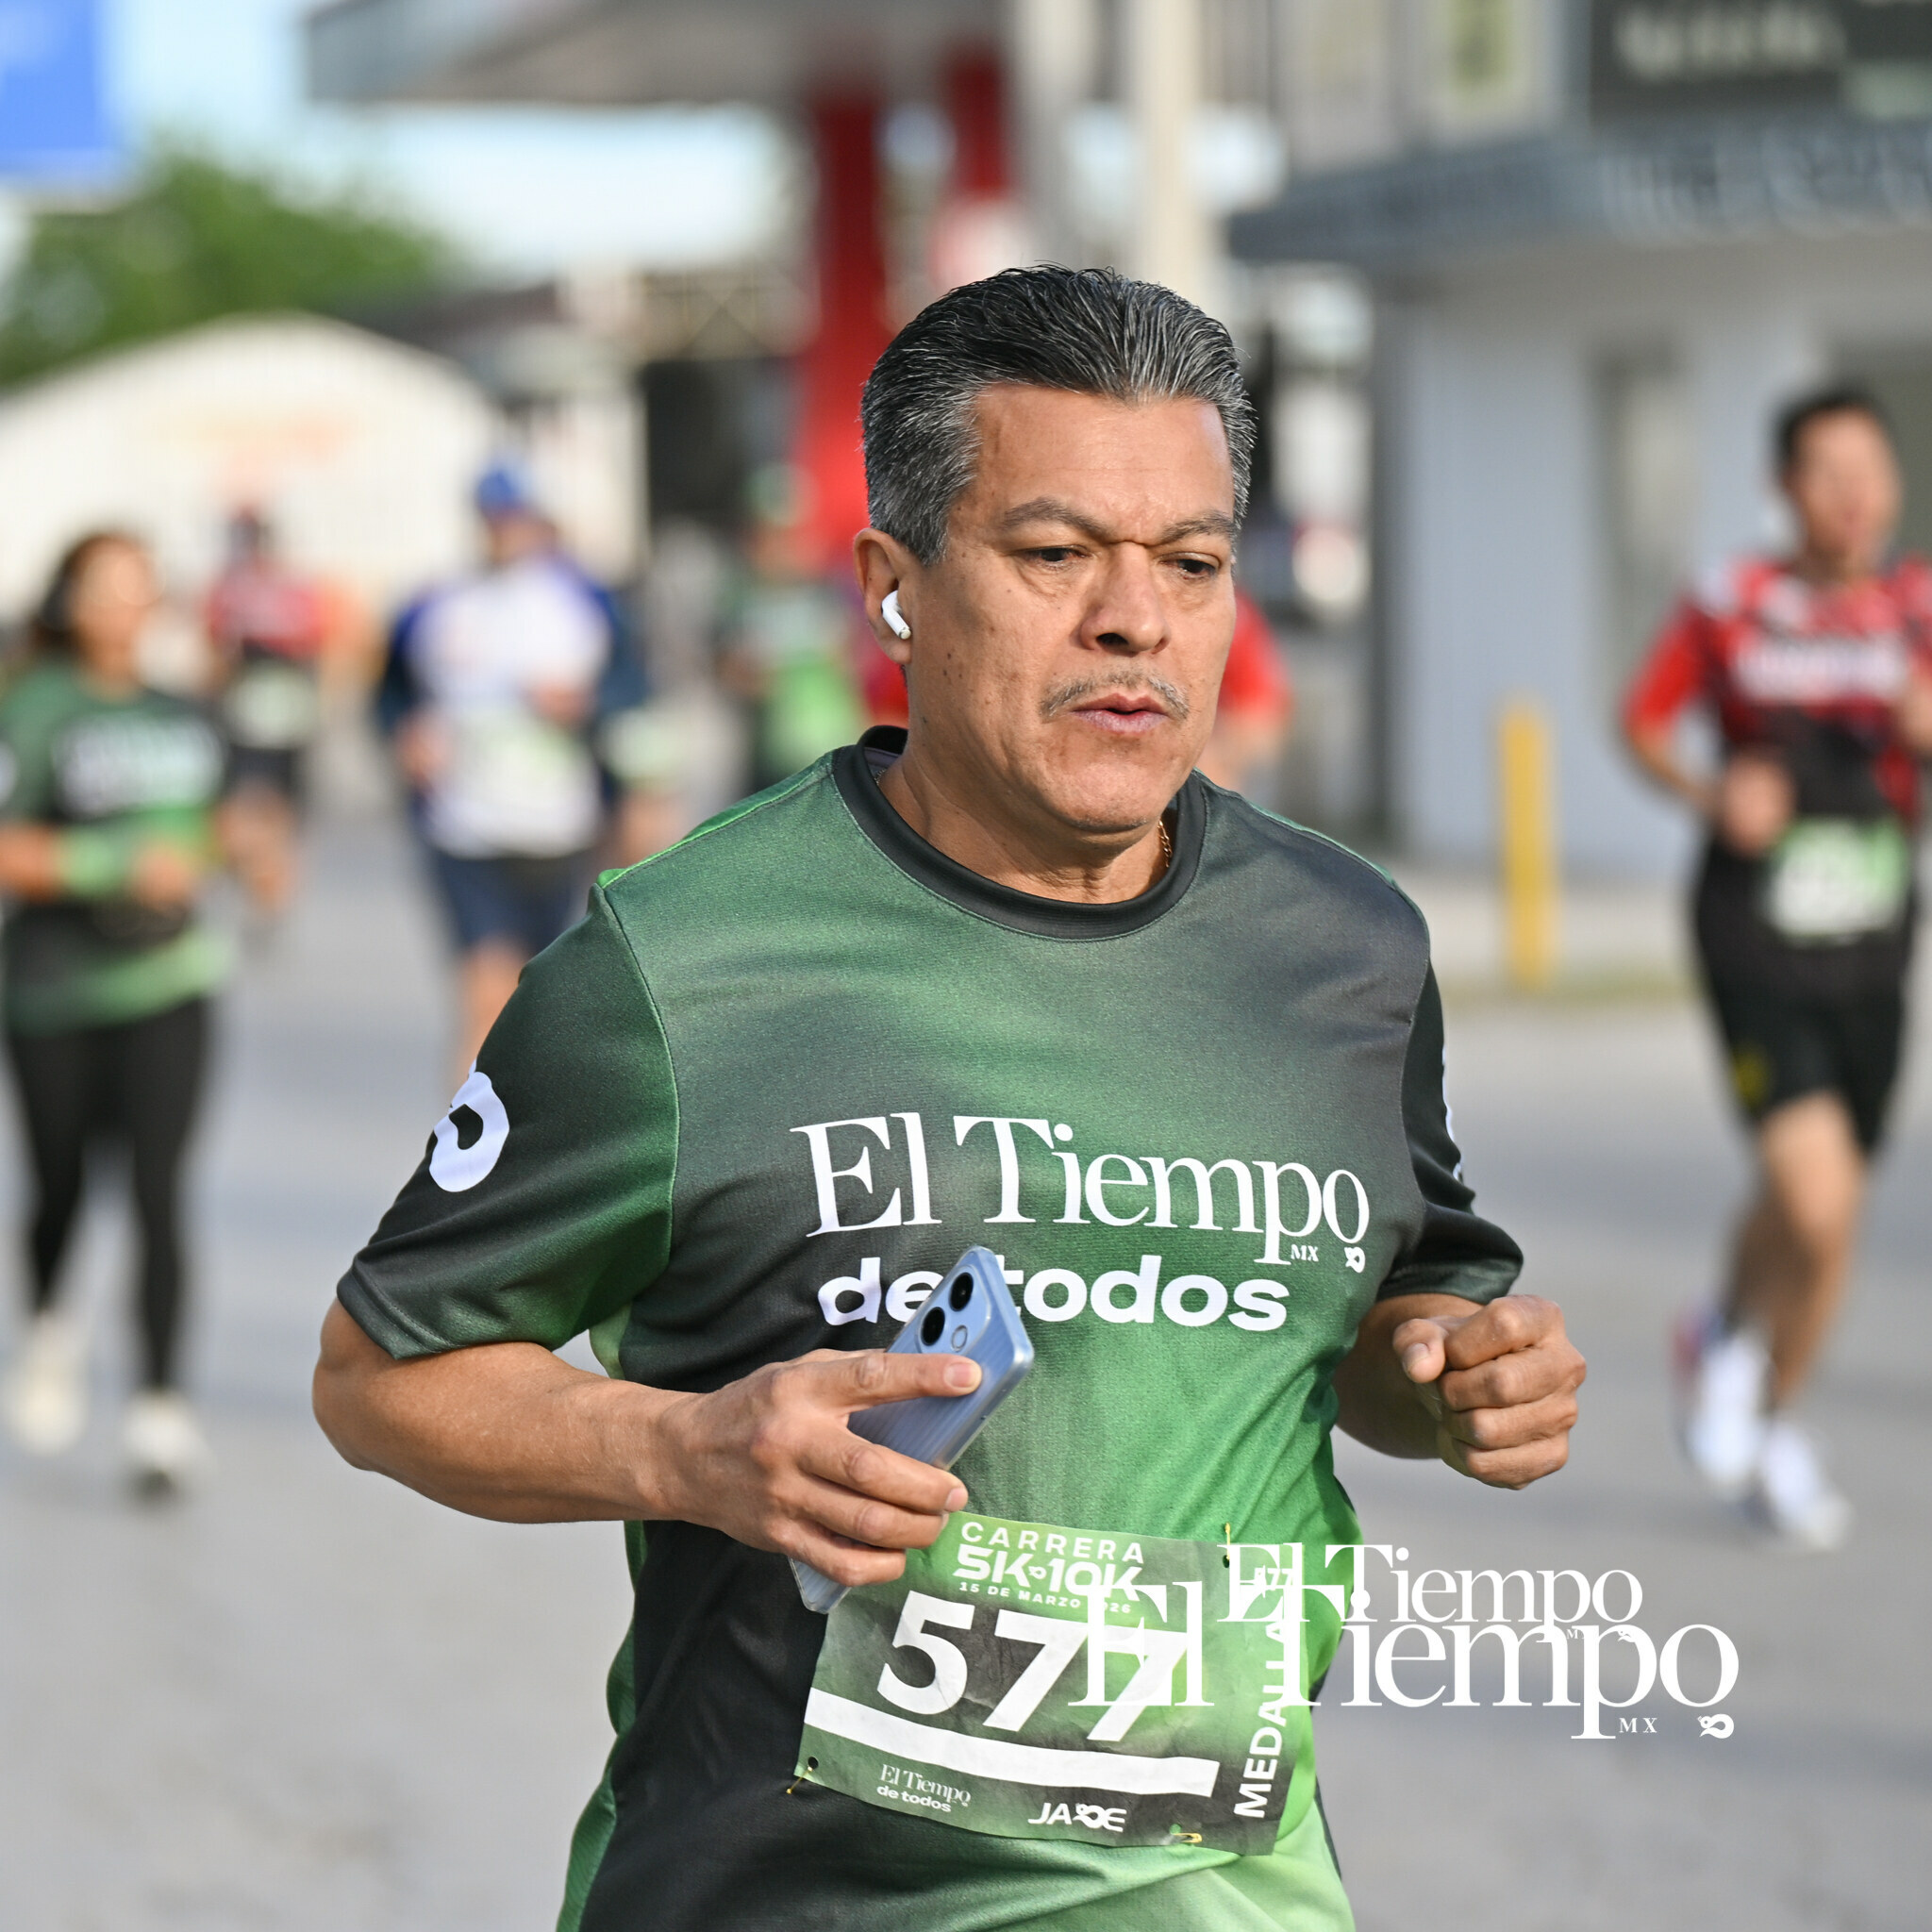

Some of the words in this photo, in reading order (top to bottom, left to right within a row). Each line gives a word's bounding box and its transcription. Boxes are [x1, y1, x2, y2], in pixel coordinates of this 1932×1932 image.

[790, 1112, 941, 1237] El
[954, 1115, 1369, 1265] Tiempo
[1291, 1244, 1319, 1261] MX
[818, 1257, 944, 1326] de
[961, 1522, 1143, 1563] CARRERA
[959, 1581, 980, 1592] 15
[988, 1586, 1010, 1597] DE
[1019, 1590, 1081, 1608] MARZO
[1253, 1567, 1296, 1591] 77
[877, 1591, 1188, 1740] 577
[876, 1786, 899, 1799] de
[901, 1791, 952, 1812] todos
[880, 1764, 900, 1785] El
[903, 1770, 972, 1804] Tiempo
